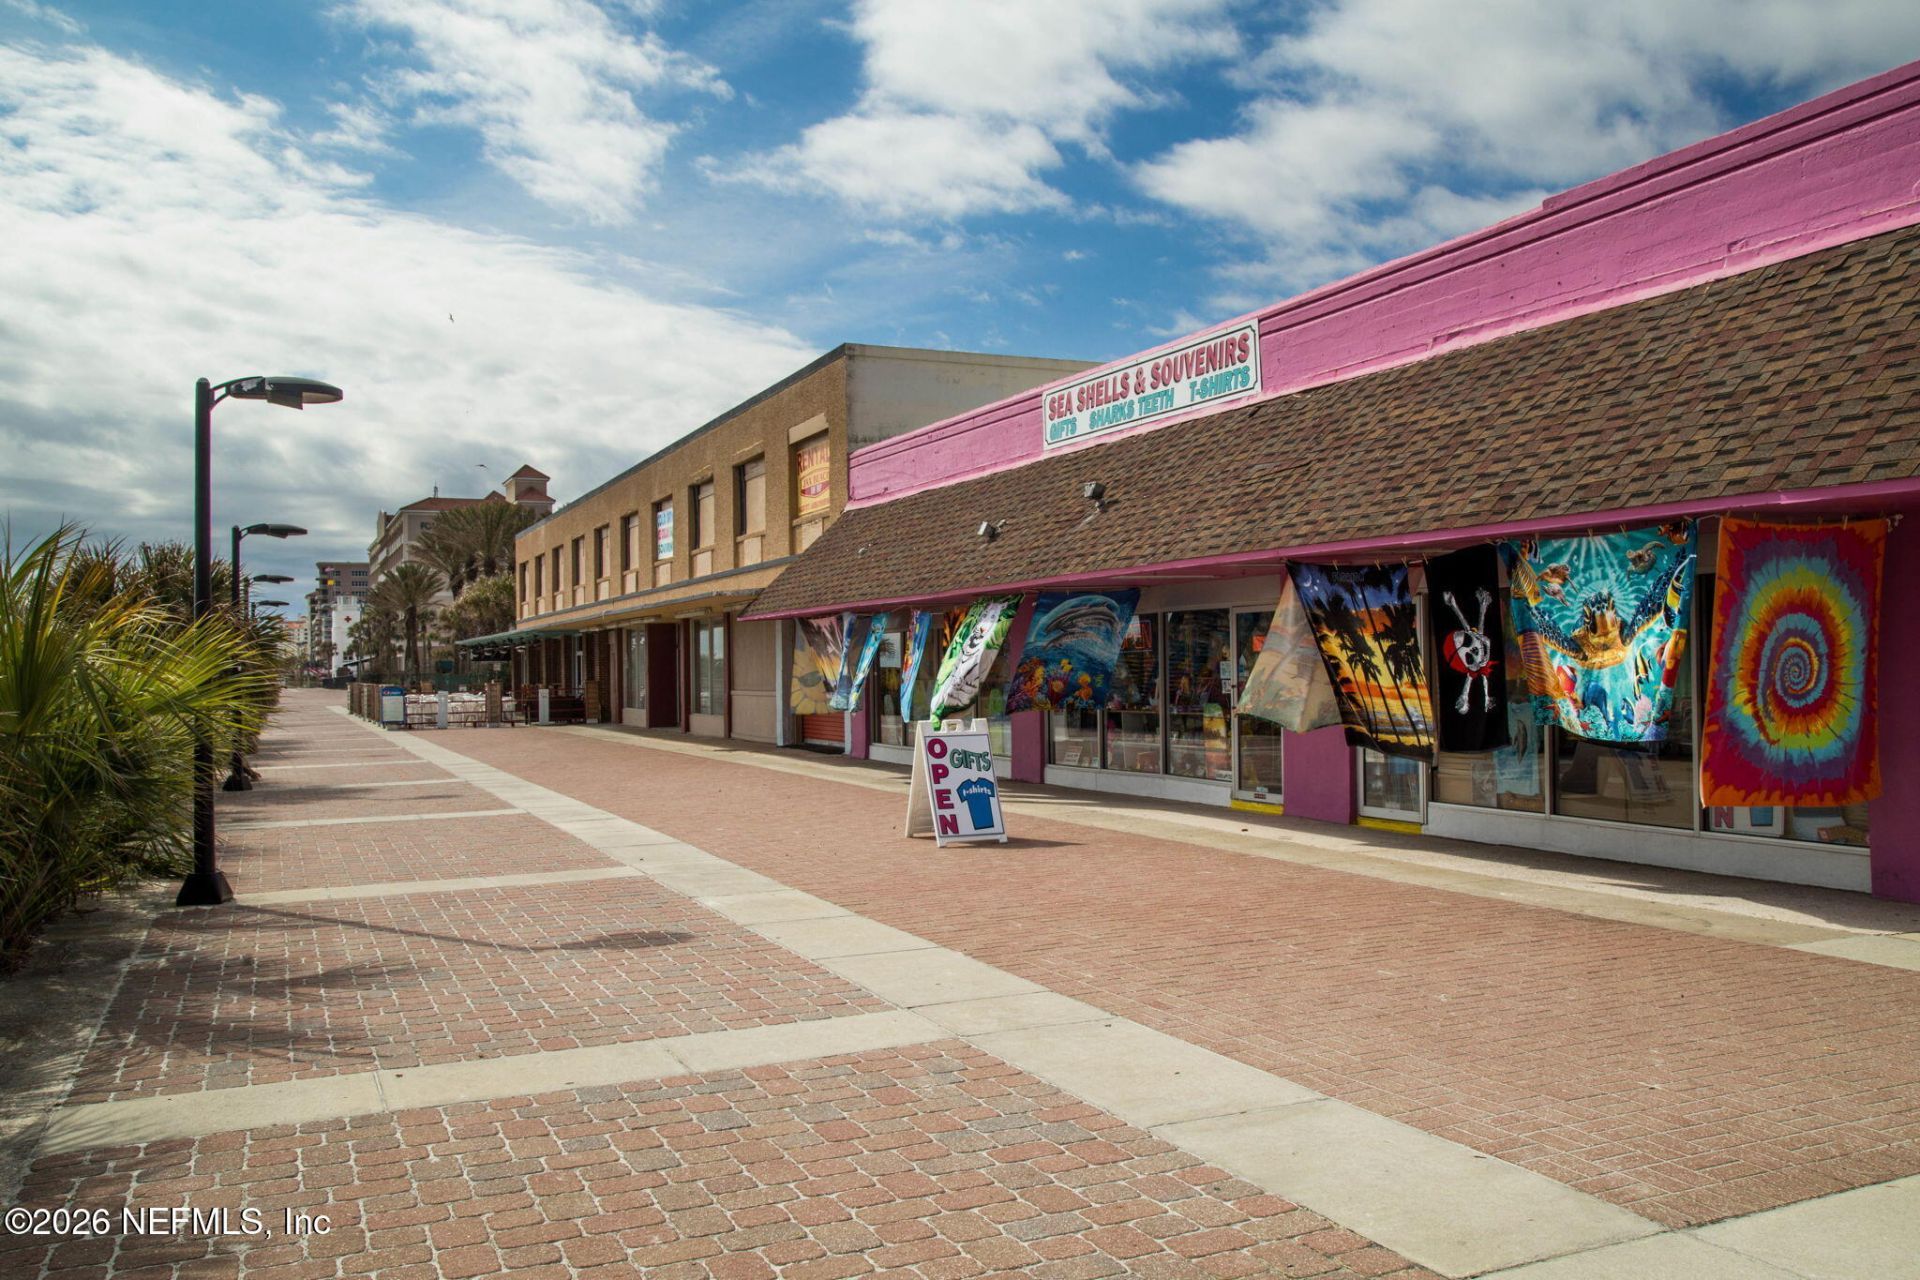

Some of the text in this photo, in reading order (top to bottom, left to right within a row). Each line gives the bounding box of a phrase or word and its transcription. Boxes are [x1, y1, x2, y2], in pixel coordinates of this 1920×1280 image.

[1049, 332, 1250, 421] SEA SHELLS & SOUVENIRS
[1050, 365, 1250, 441] GIFTS SHARKS TEETH T-SHIRTS
[927, 738, 960, 835] OPEN
[950, 748, 991, 772] GIFTS
[962, 784, 992, 797] t-shirts
